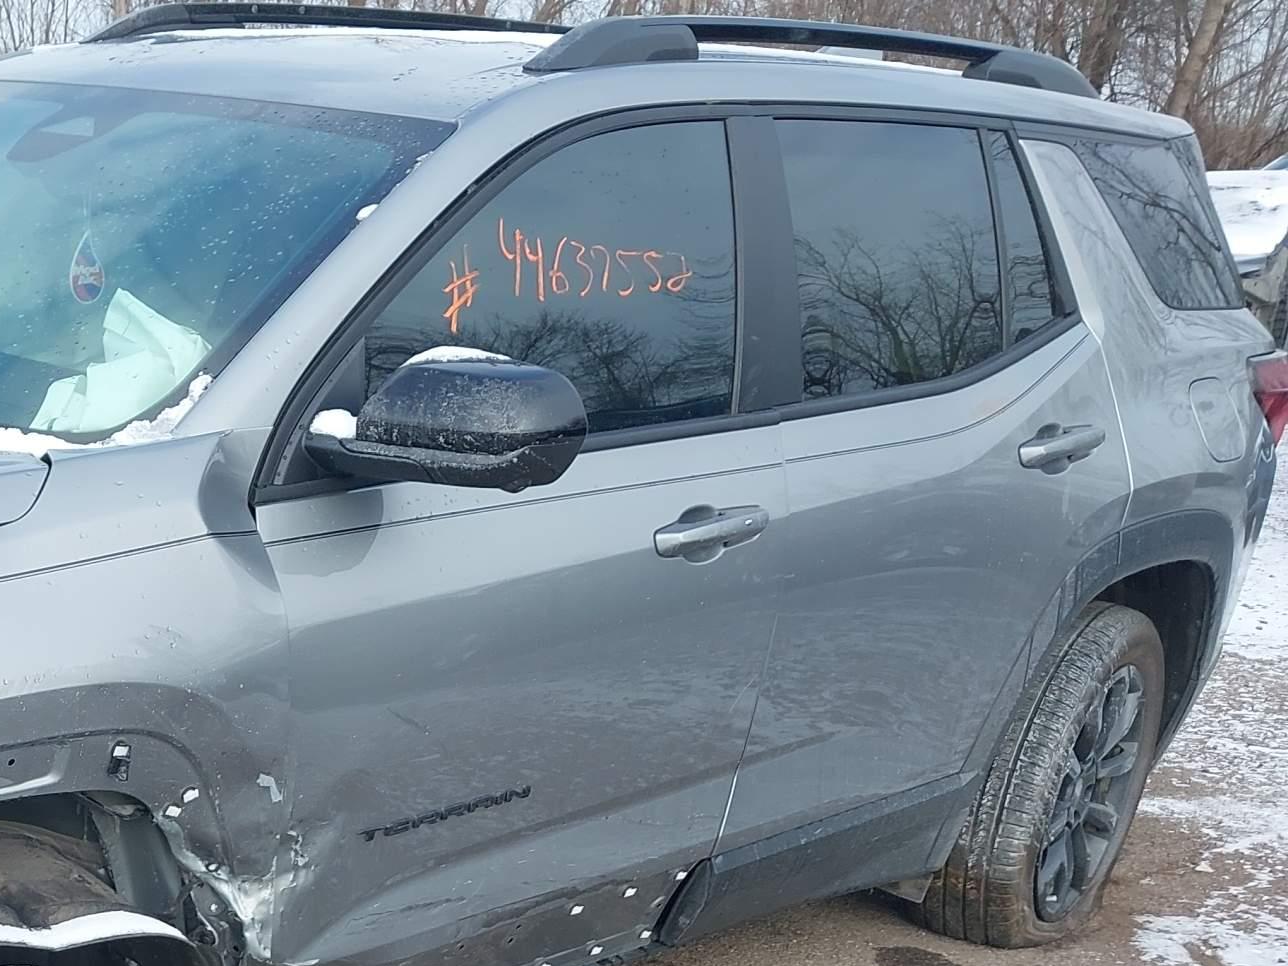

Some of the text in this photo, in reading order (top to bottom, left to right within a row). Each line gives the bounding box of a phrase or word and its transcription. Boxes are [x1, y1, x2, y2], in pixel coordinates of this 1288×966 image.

[442, 216, 693, 335] # 44637552
[356, 785, 533, 843] TERRAIN
